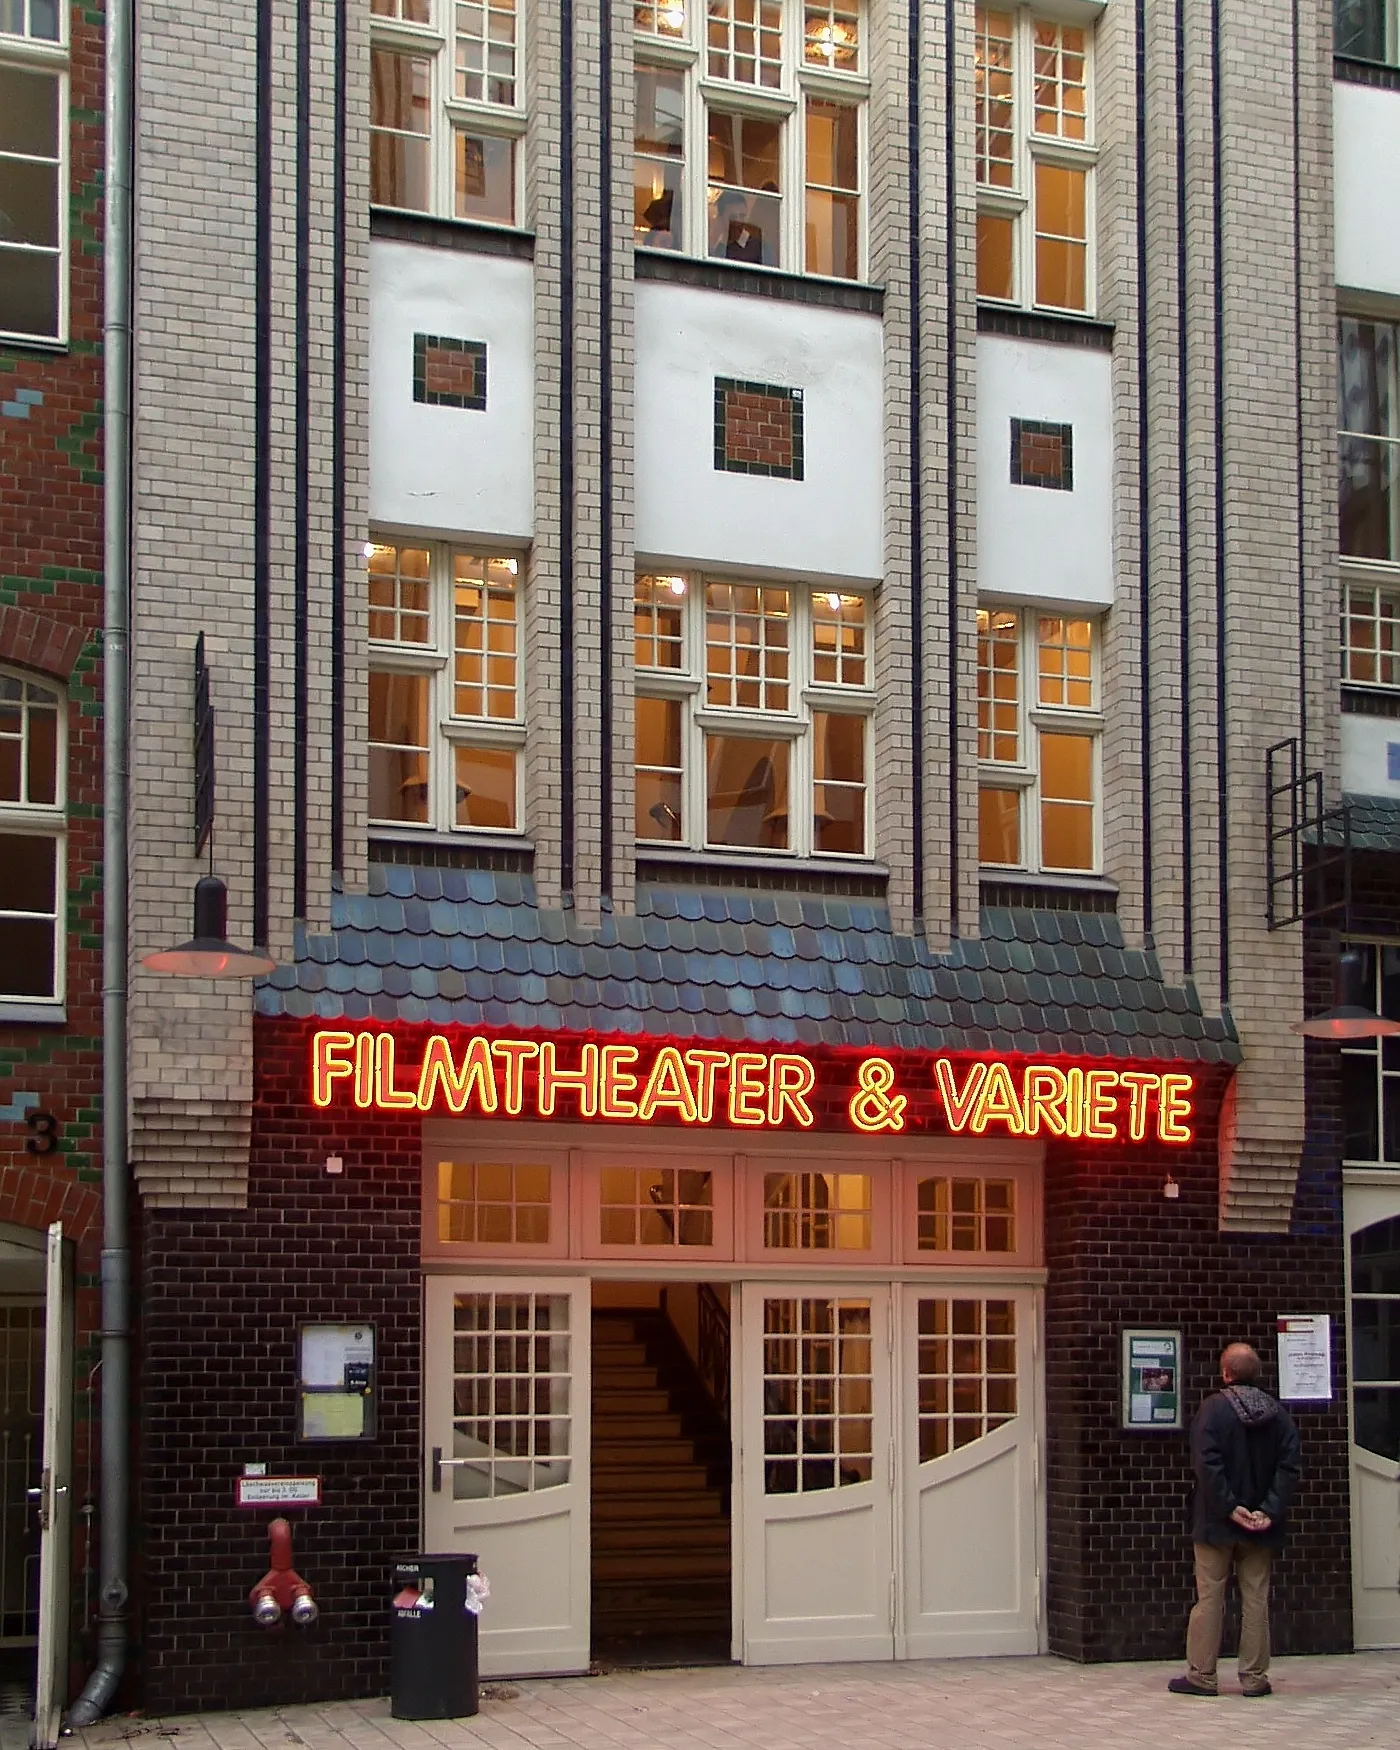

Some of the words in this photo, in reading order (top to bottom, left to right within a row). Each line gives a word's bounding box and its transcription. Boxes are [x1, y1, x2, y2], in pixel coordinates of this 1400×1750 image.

[312, 1031, 815, 1127] FILMTHEATER
[849, 1057, 907, 1132] &
[933, 1058, 1193, 1143] VARIETE
[26, 1113, 57, 1156] 3
